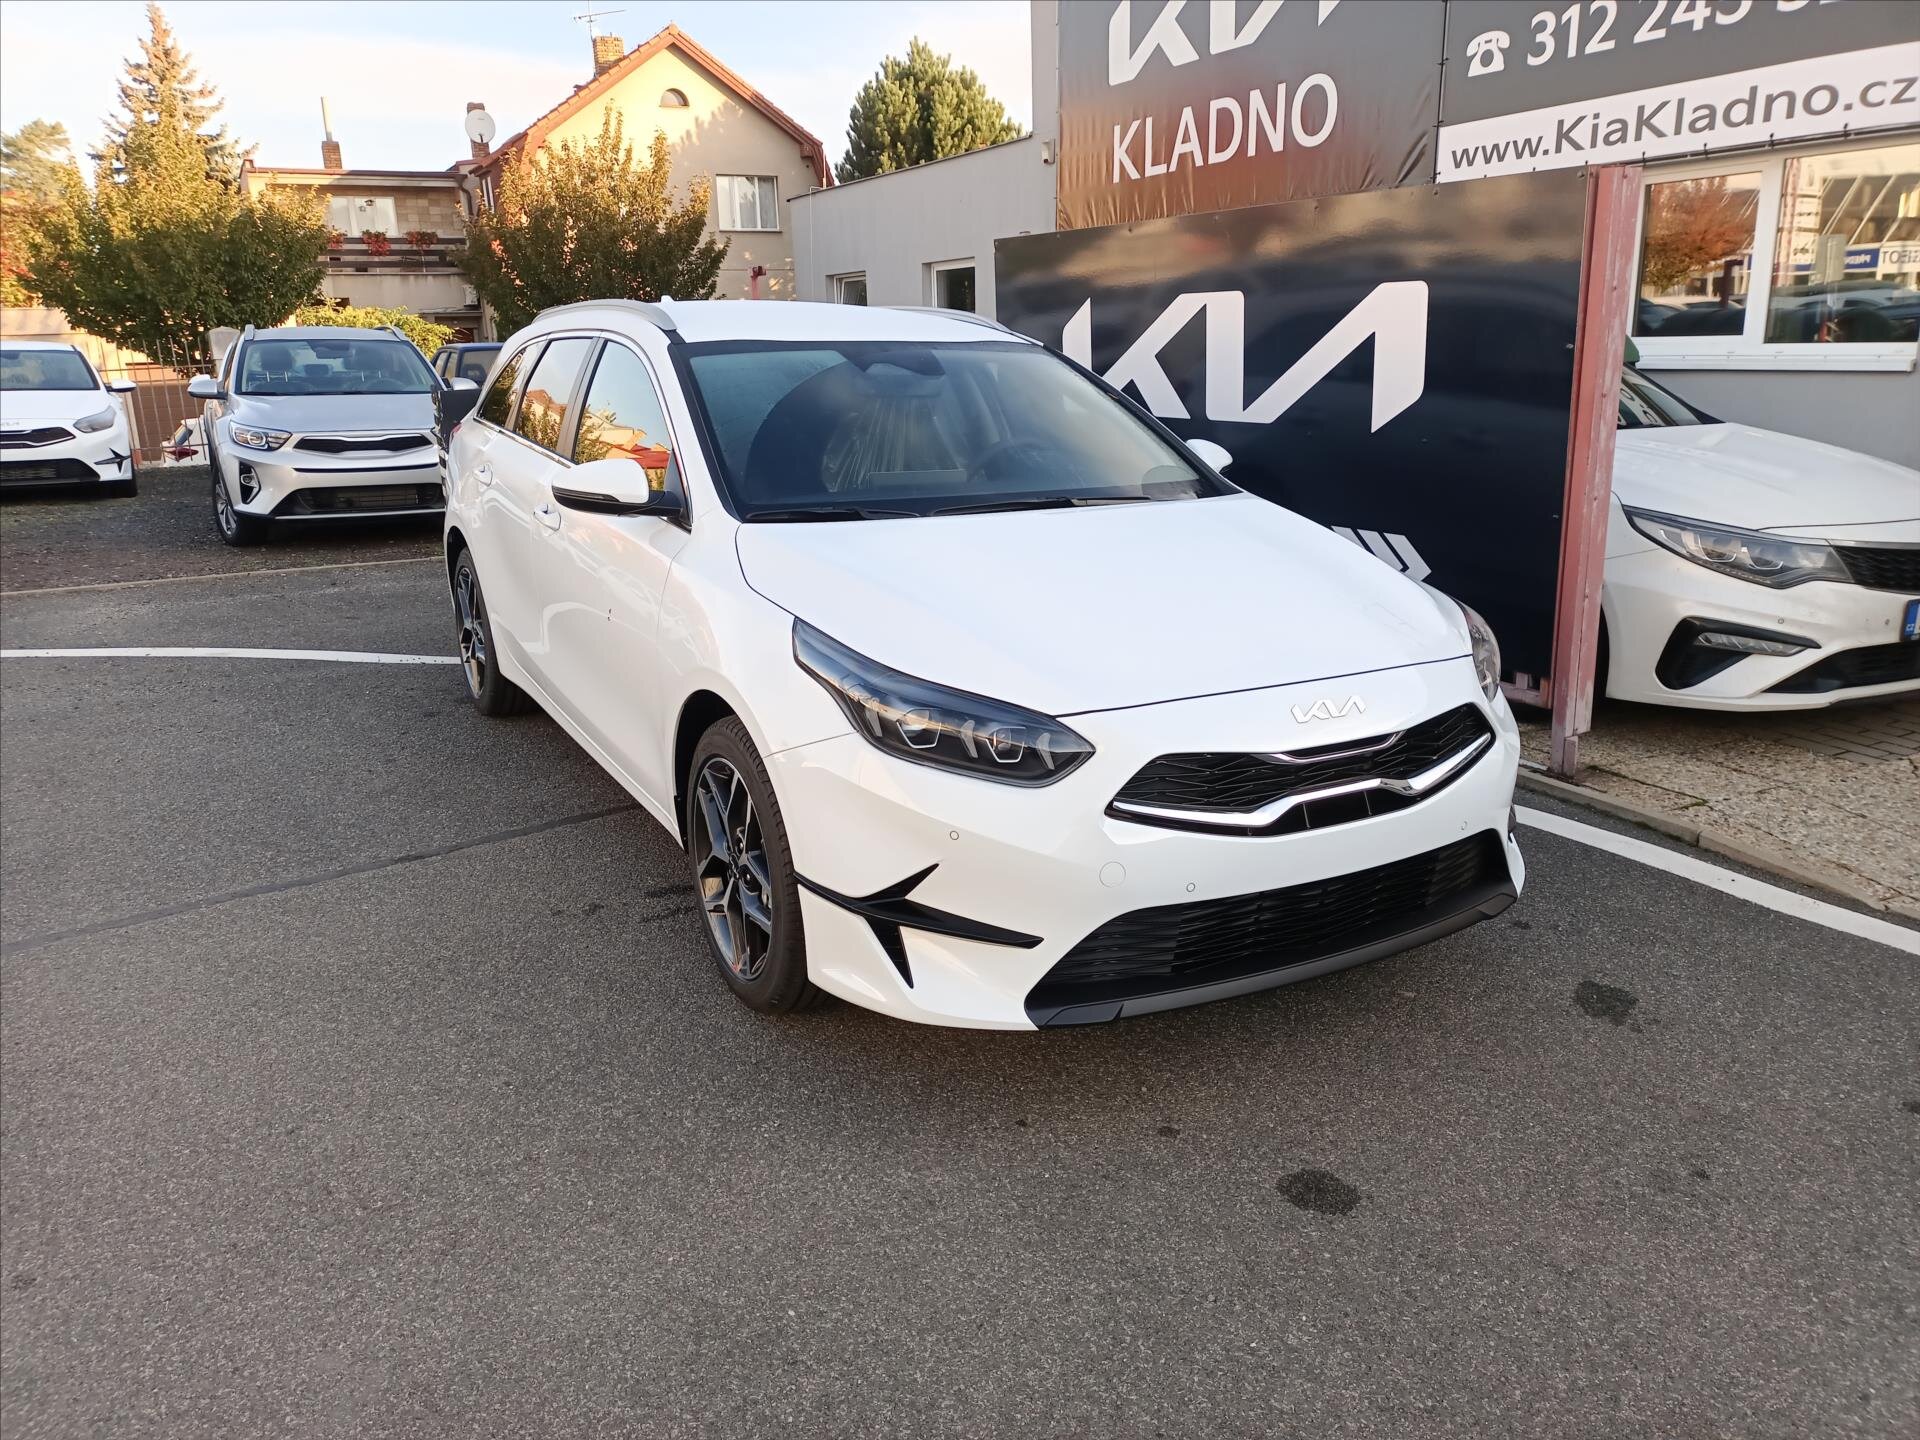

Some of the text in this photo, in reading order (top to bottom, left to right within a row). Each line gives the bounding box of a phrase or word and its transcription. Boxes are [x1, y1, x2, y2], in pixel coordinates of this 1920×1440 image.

[1526, 0, 1617, 66] 312
[1112, 73, 1338, 183] KLADNO
[1451, 76, 1920, 169] www.KiaKladno.cz
[1062, 280, 1429, 433] KIA
[1290, 696, 1367, 724] KIA
